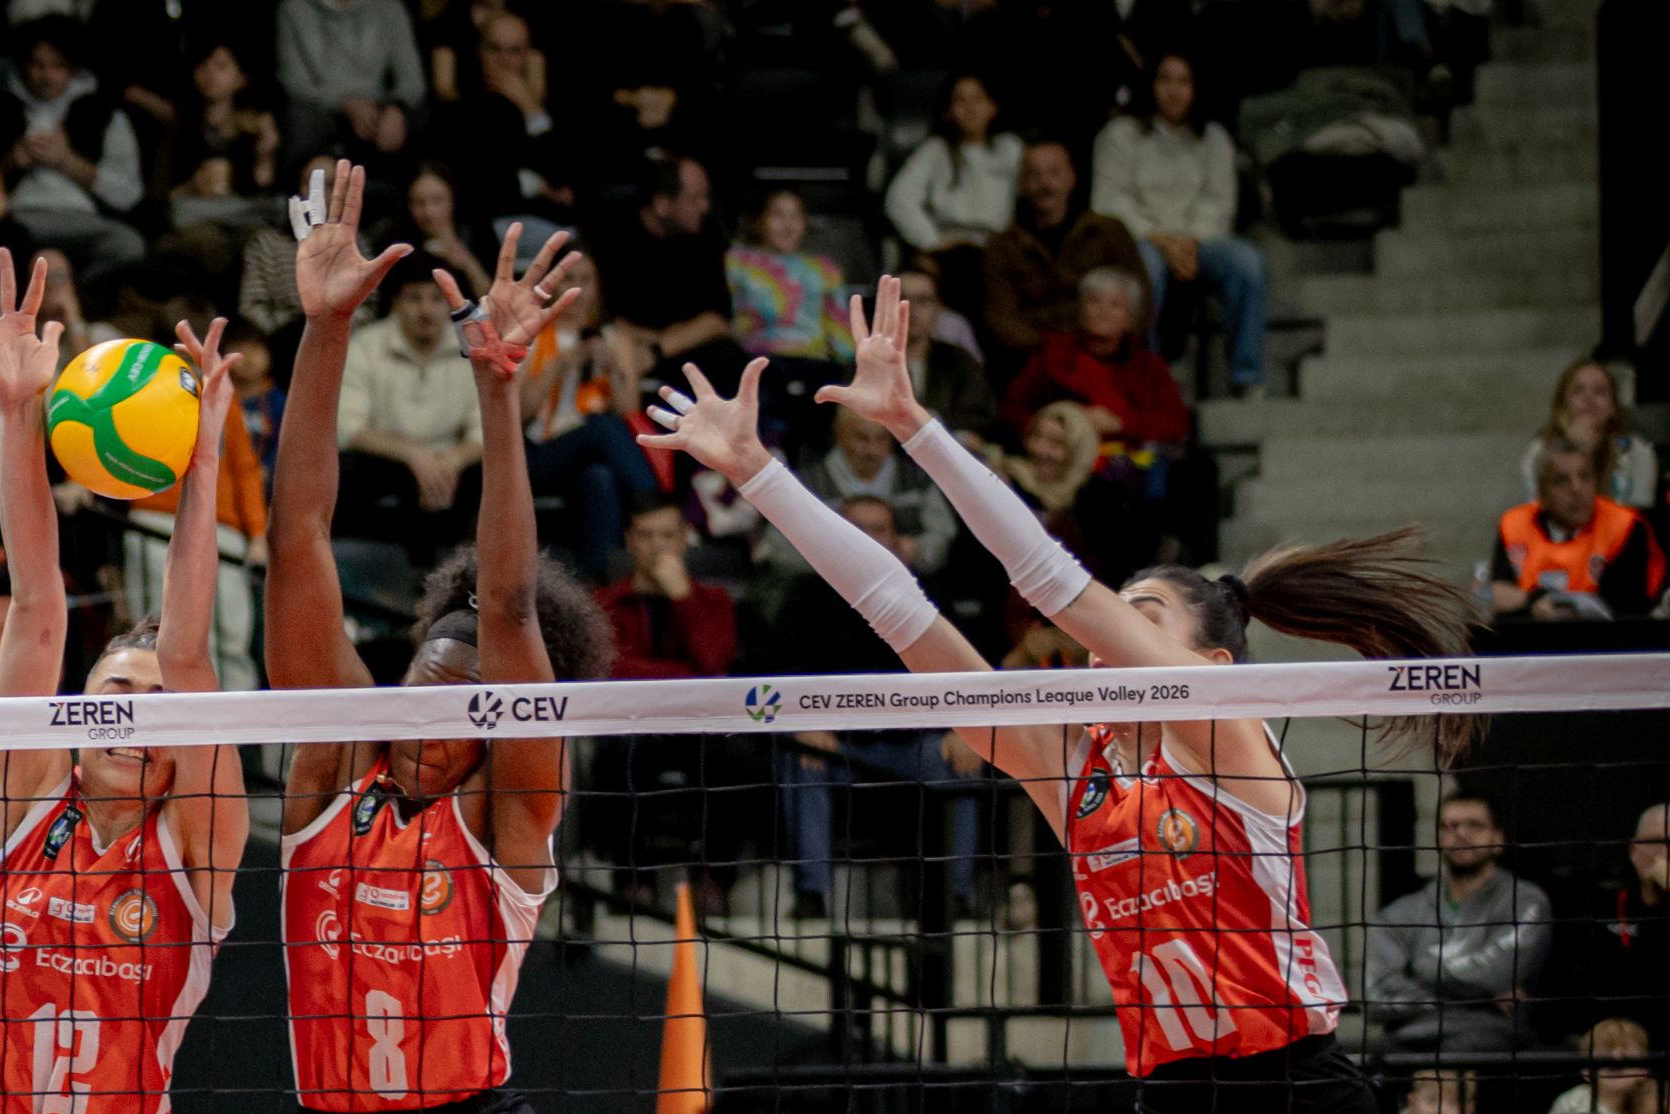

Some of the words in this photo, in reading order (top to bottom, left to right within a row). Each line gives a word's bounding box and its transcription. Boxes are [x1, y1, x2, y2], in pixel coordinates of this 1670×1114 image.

[1388, 664, 1481, 691] ZEREN
[511, 696, 569, 722] CEV
[799, 694, 832, 710] CEV
[836, 693, 886, 709] ZEREN
[890, 691, 939, 709] Group
[943, 689, 1032, 708] Champions
[1035, 687, 1094, 706] League
[1097, 685, 1147, 704] Volley
[1150, 684, 1190, 701] 2026
[1430, 692, 1482, 706] GROUP
[49, 700, 134, 727] ZEREN
[87, 727, 136, 742] GROUP
[1130, 938, 1238, 1052] 10
[364, 988, 409, 1101] 8
